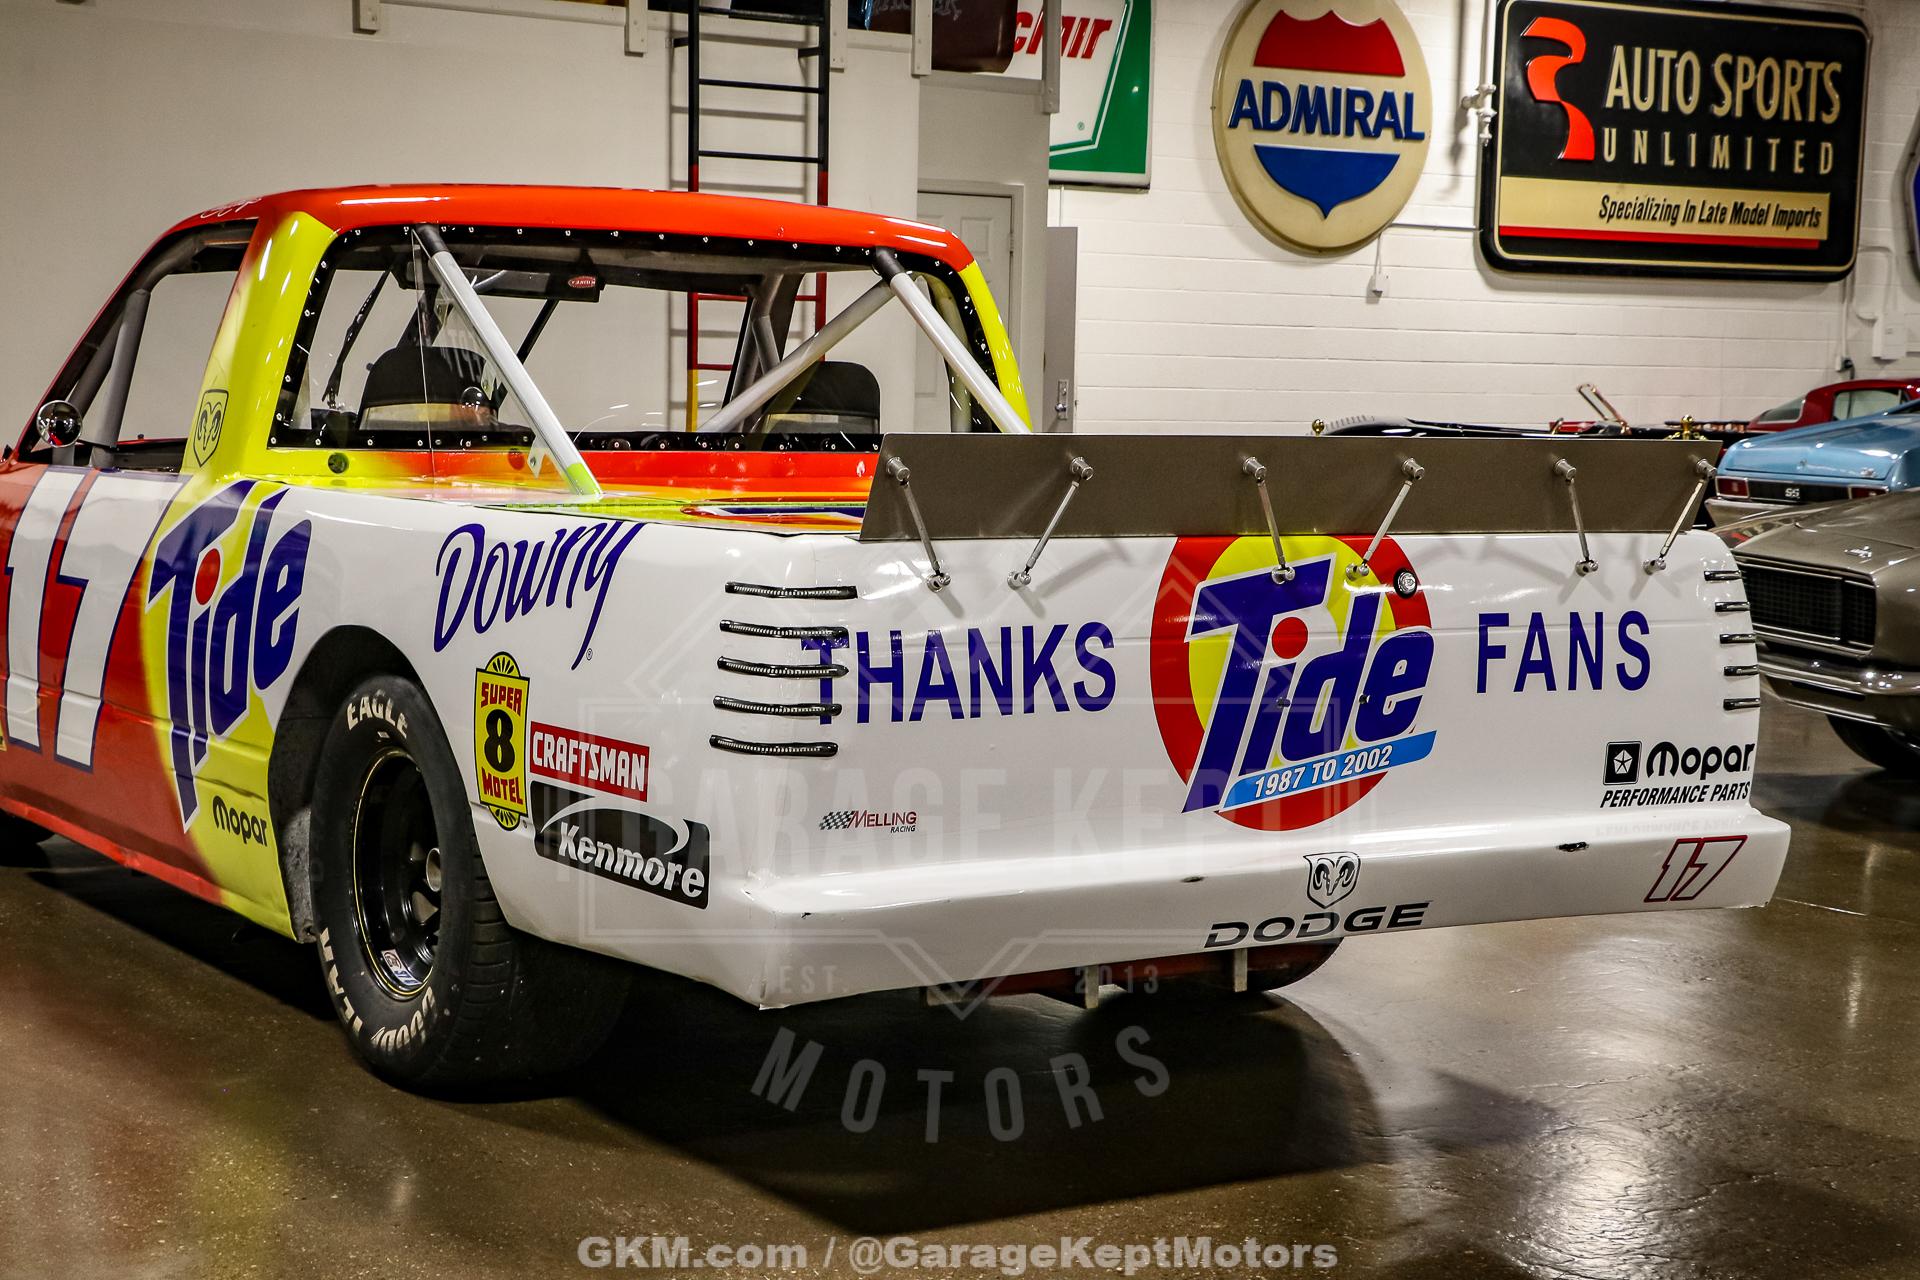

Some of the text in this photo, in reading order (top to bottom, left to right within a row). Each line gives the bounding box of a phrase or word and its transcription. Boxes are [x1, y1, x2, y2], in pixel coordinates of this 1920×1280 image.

[1228, 78, 1425, 141] ADMIRAL
[1605, 45, 1842, 124] AUTO SPORTS
[1603, 127, 1834, 175] UNLIMITED
[1599, 194, 1822, 230] Specializing In Late Model Imports
[4, 468, 194, 773] 17
[433, 519, 648, 671] Downy
[145, 479, 313, 832] Tide
[801, 621, 1116, 724] THANKS
[1477, 610, 1651, 694] FANS
[481, 682, 523, 717] SUPER
[1183, 553, 1436, 813] Tide
[347, 689, 408, 739] EAGLE
[484, 708, 515, 773] 8
[481, 766, 524, 806] MOTEL
[532, 731, 646, 792] CRAFTSMAN
[1254, 744, 1393, 798] 1987 TO 2002
[1646, 741, 1755, 780] Mopar
[212, 795, 268, 847] Mopar
[1600, 781, 1751, 808] PERFORMANCE PARTS
[558, 821, 705, 898] Kenmore
[890, 825, 917, 834] RACING
[1643, 834, 1749, 903] 17
[1203, 901, 1433, 949] DODGE
